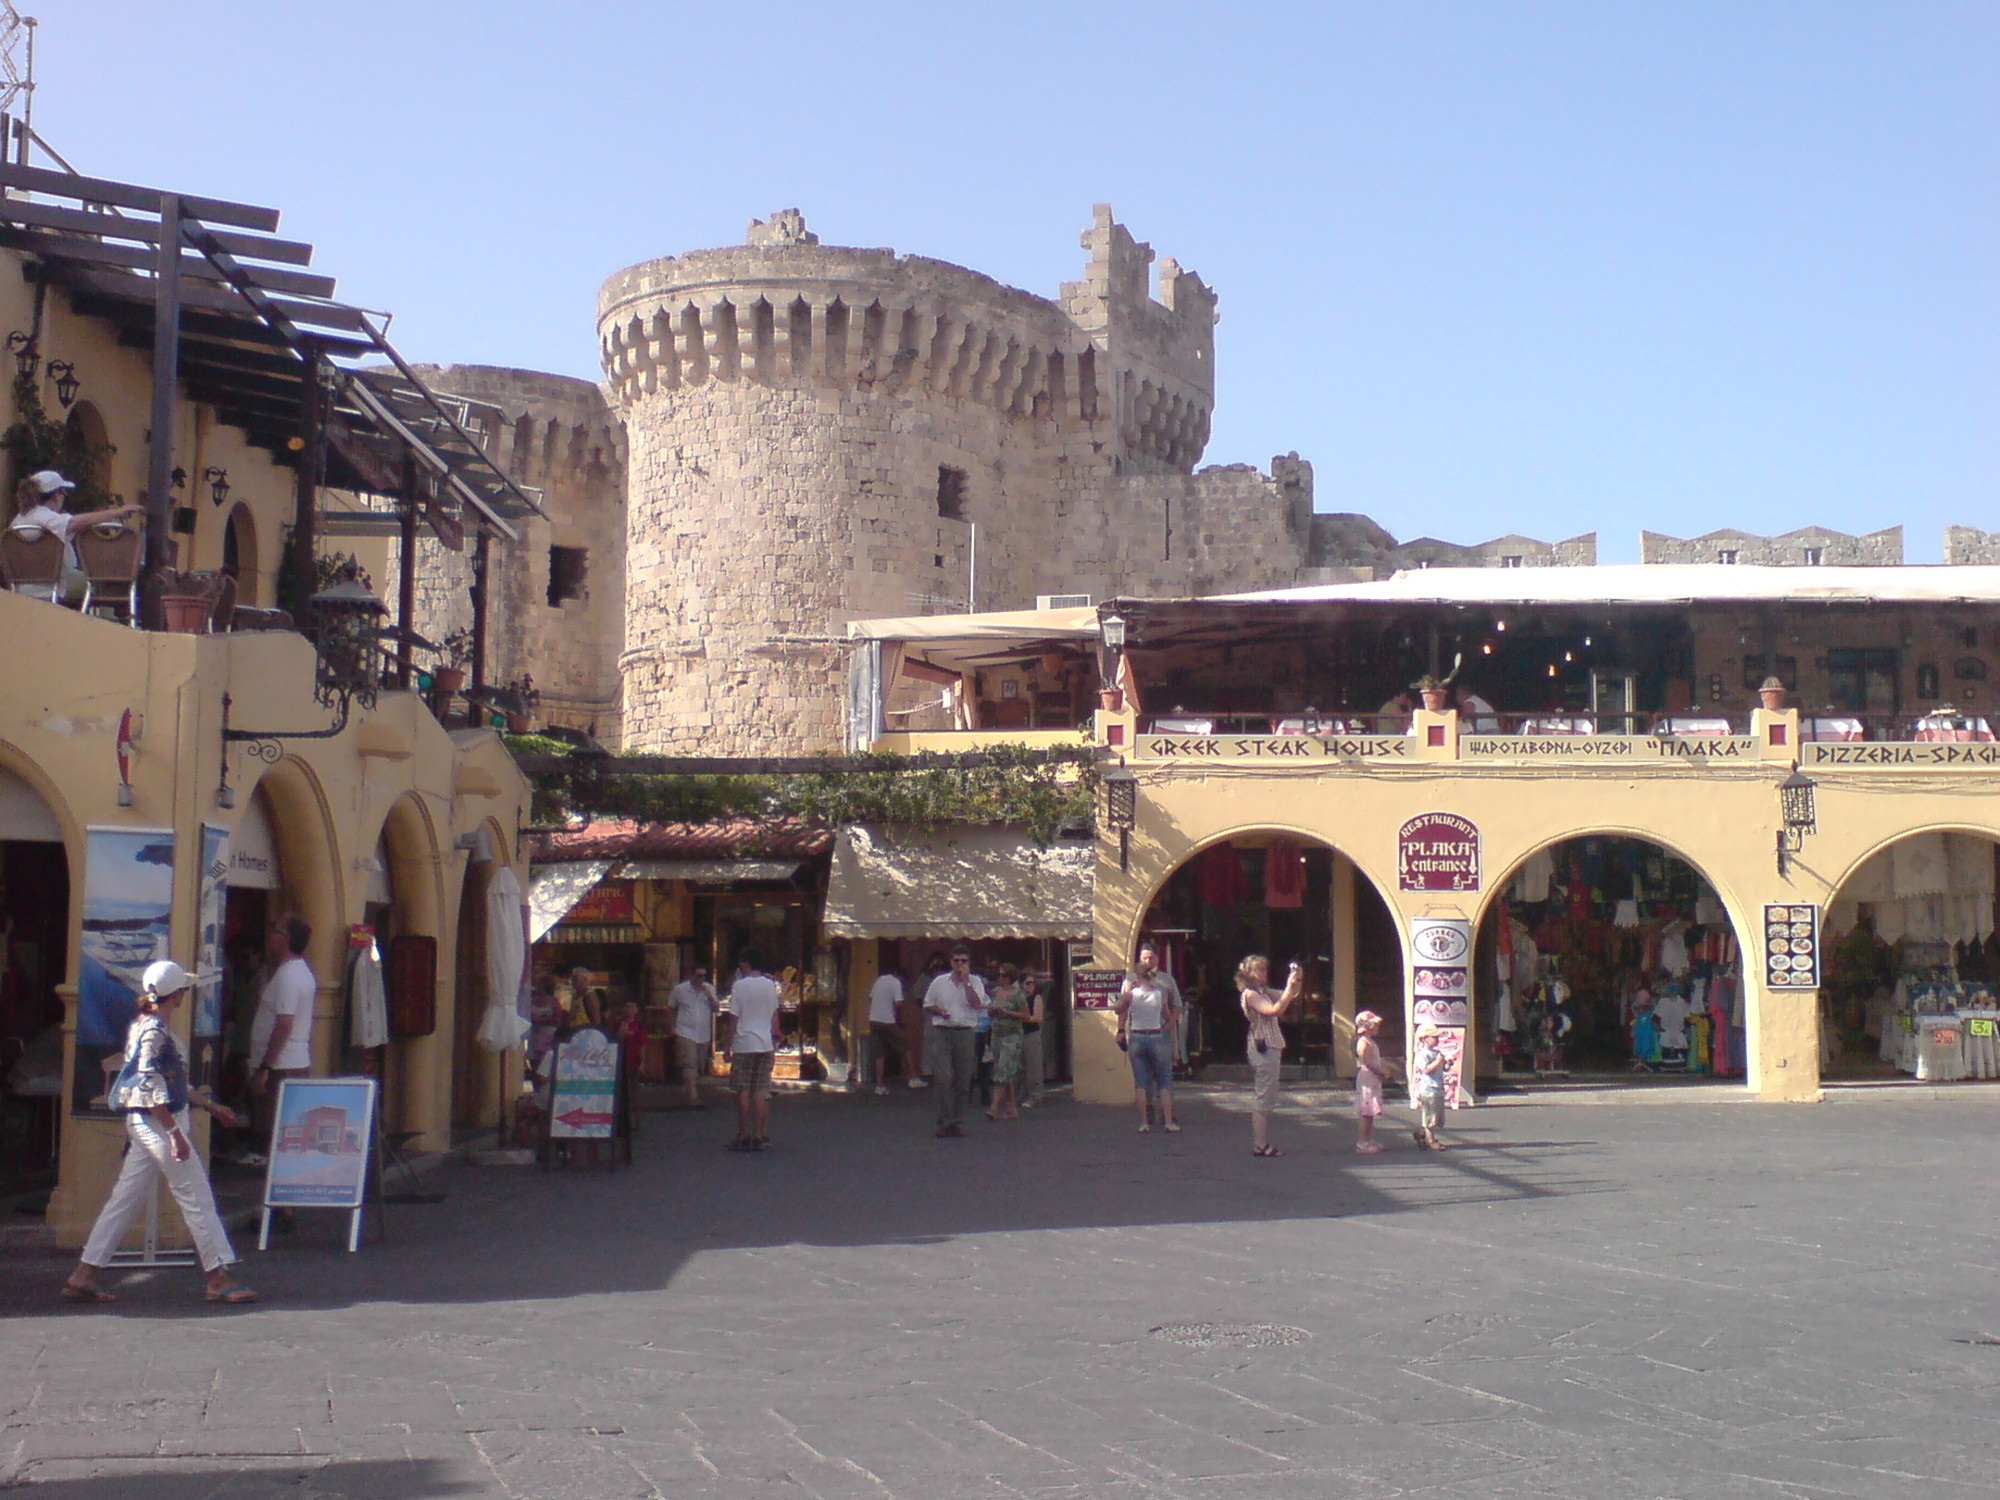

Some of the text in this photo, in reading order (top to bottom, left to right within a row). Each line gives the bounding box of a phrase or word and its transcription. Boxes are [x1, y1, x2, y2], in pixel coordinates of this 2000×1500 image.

[1149, 739, 1406, 757] GREEK STEAK HOUSE
[1400, 814, 1478, 839] RESTAURANT
[1411, 858, 1468, 872] entrance
